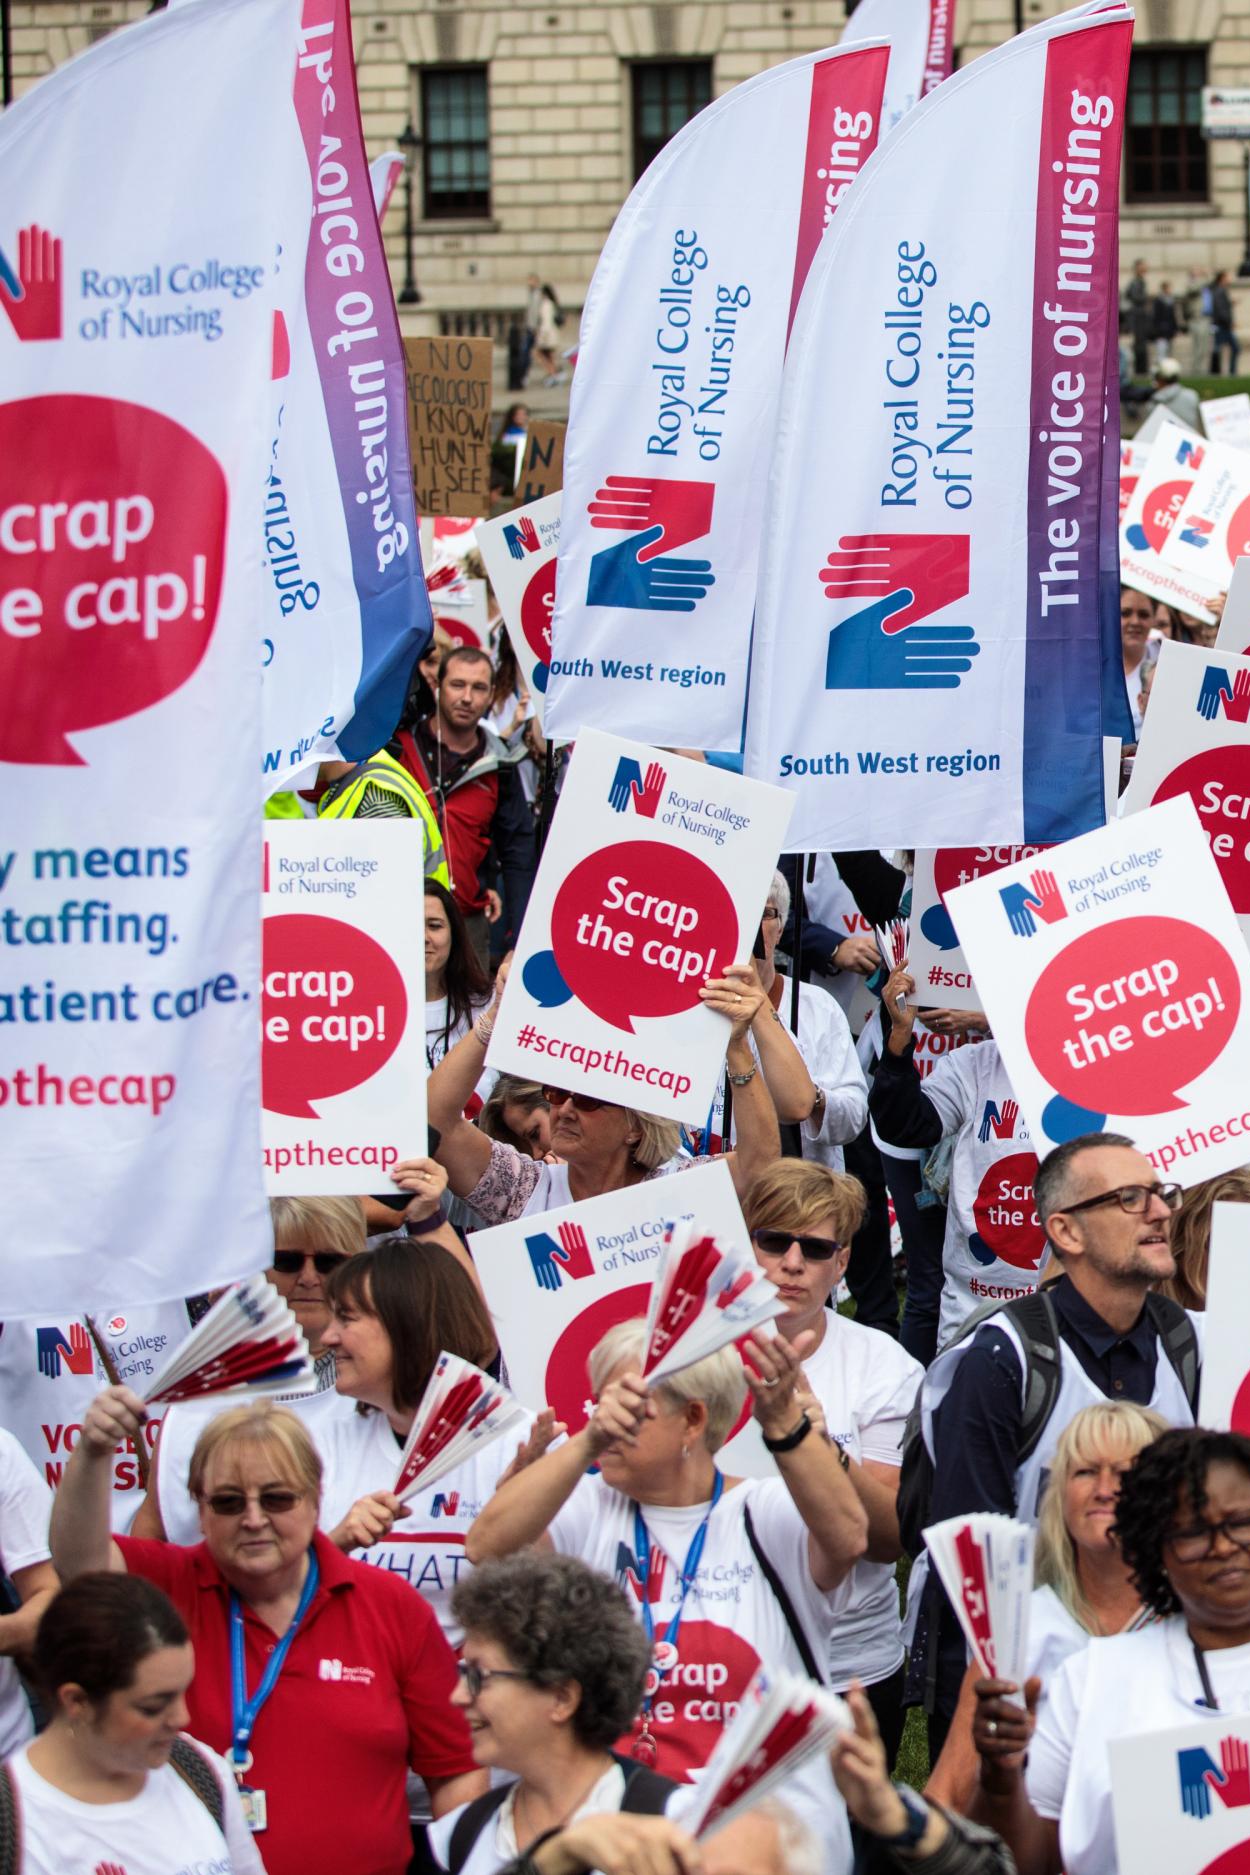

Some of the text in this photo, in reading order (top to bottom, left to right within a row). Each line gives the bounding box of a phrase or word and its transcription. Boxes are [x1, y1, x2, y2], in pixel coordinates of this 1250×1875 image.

[80, 261, 265, 305] Royal College
[80, 306, 224, 340] of Nursing
[647, 229, 708, 456] Royal College
[430, 342, 473, 371] NO
[694, 284, 751, 461] of Nursing
[1039, 89, 1114, 617] The voice of nursing
[881, 241, 937, 506] Royal College
[427, 405, 489, 442] KNOW
[933, 301, 990, 510] of Nursing
[420, 436, 484, 466] HUNT
[444, 466, 483, 494] SEE
[601, 660, 726, 687] West region
[780, 749, 1000, 777] South West region
[662, 810, 727, 845] of Nursing
[667, 791, 750, 830] Royal College
[278, 856, 379, 878] Royal College
[1067, 846, 1164, 899] Royal College
[278, 877, 357, 898] of Nursing
[601, 875, 699, 934] Scrap
[1075, 873, 1151, 913] of Nursing
[577, 913, 717, 982] the cap!
[1066, 958, 1180, 1022] Scrap
[1062, 977, 1226, 1070] the cap!
[517, 1024, 692, 1099] #scrapthecap
[119, 1333, 167, 1358] College
